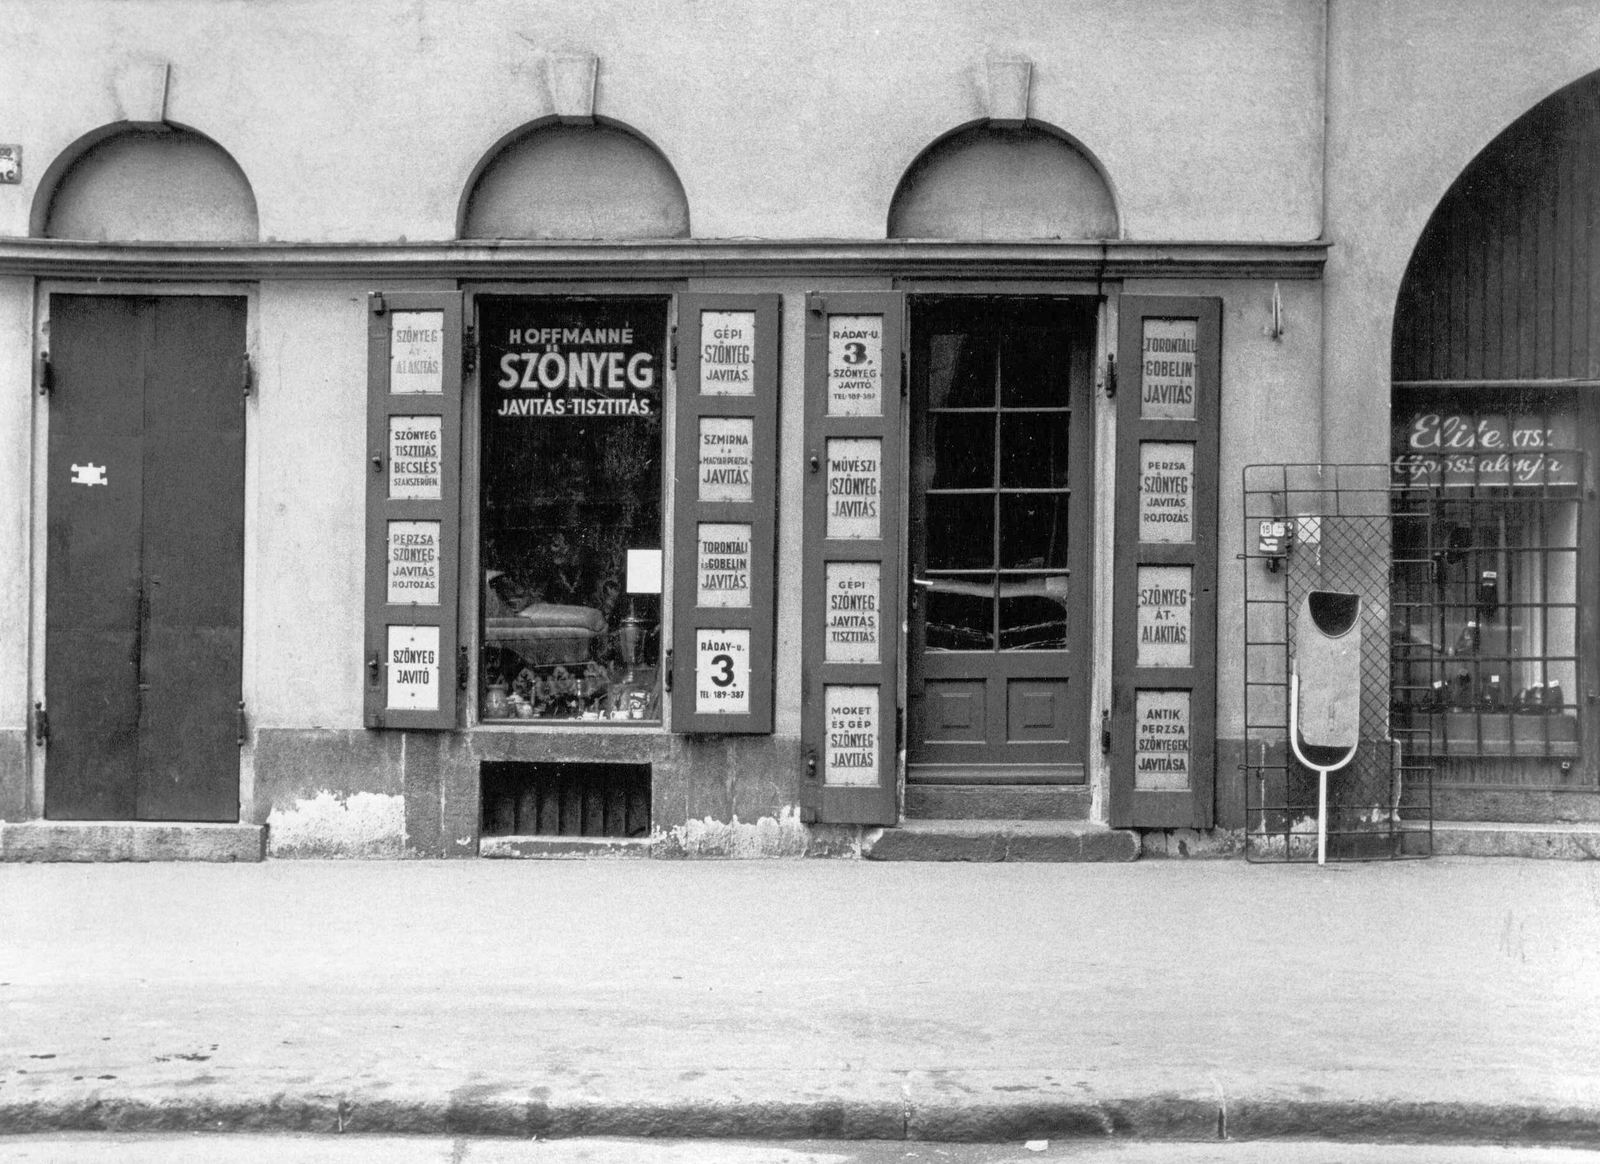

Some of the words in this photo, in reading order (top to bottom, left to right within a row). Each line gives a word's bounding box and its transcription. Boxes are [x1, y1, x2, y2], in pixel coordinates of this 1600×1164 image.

[509, 321, 634, 344] HOFFMANNÉ
[714, 324, 742, 339] GÉPI
[1146, 360, 1193, 378] GOBELIN
[704, 435, 749, 445] SZMIRNA
[1149, 462, 1186, 471] PERZSA
[393, 534, 434, 545] PERZSA
[709, 558, 747, 569] GOBELIN
[839, 577, 865, 590] GÉPI
[397, 667, 430, 684] JAVITÓ
[714, 691, 745, 699] 189-387
[832, 707, 872, 715] MOKET
[1147, 709, 1181, 720] ANTIK
[832, 717, 845, 729] ÉS
[848, 717, 871, 729] GÉP
[1142, 725, 1185, 735] PERZSA
[1139, 754, 1186, 771] JAVITÁSA
